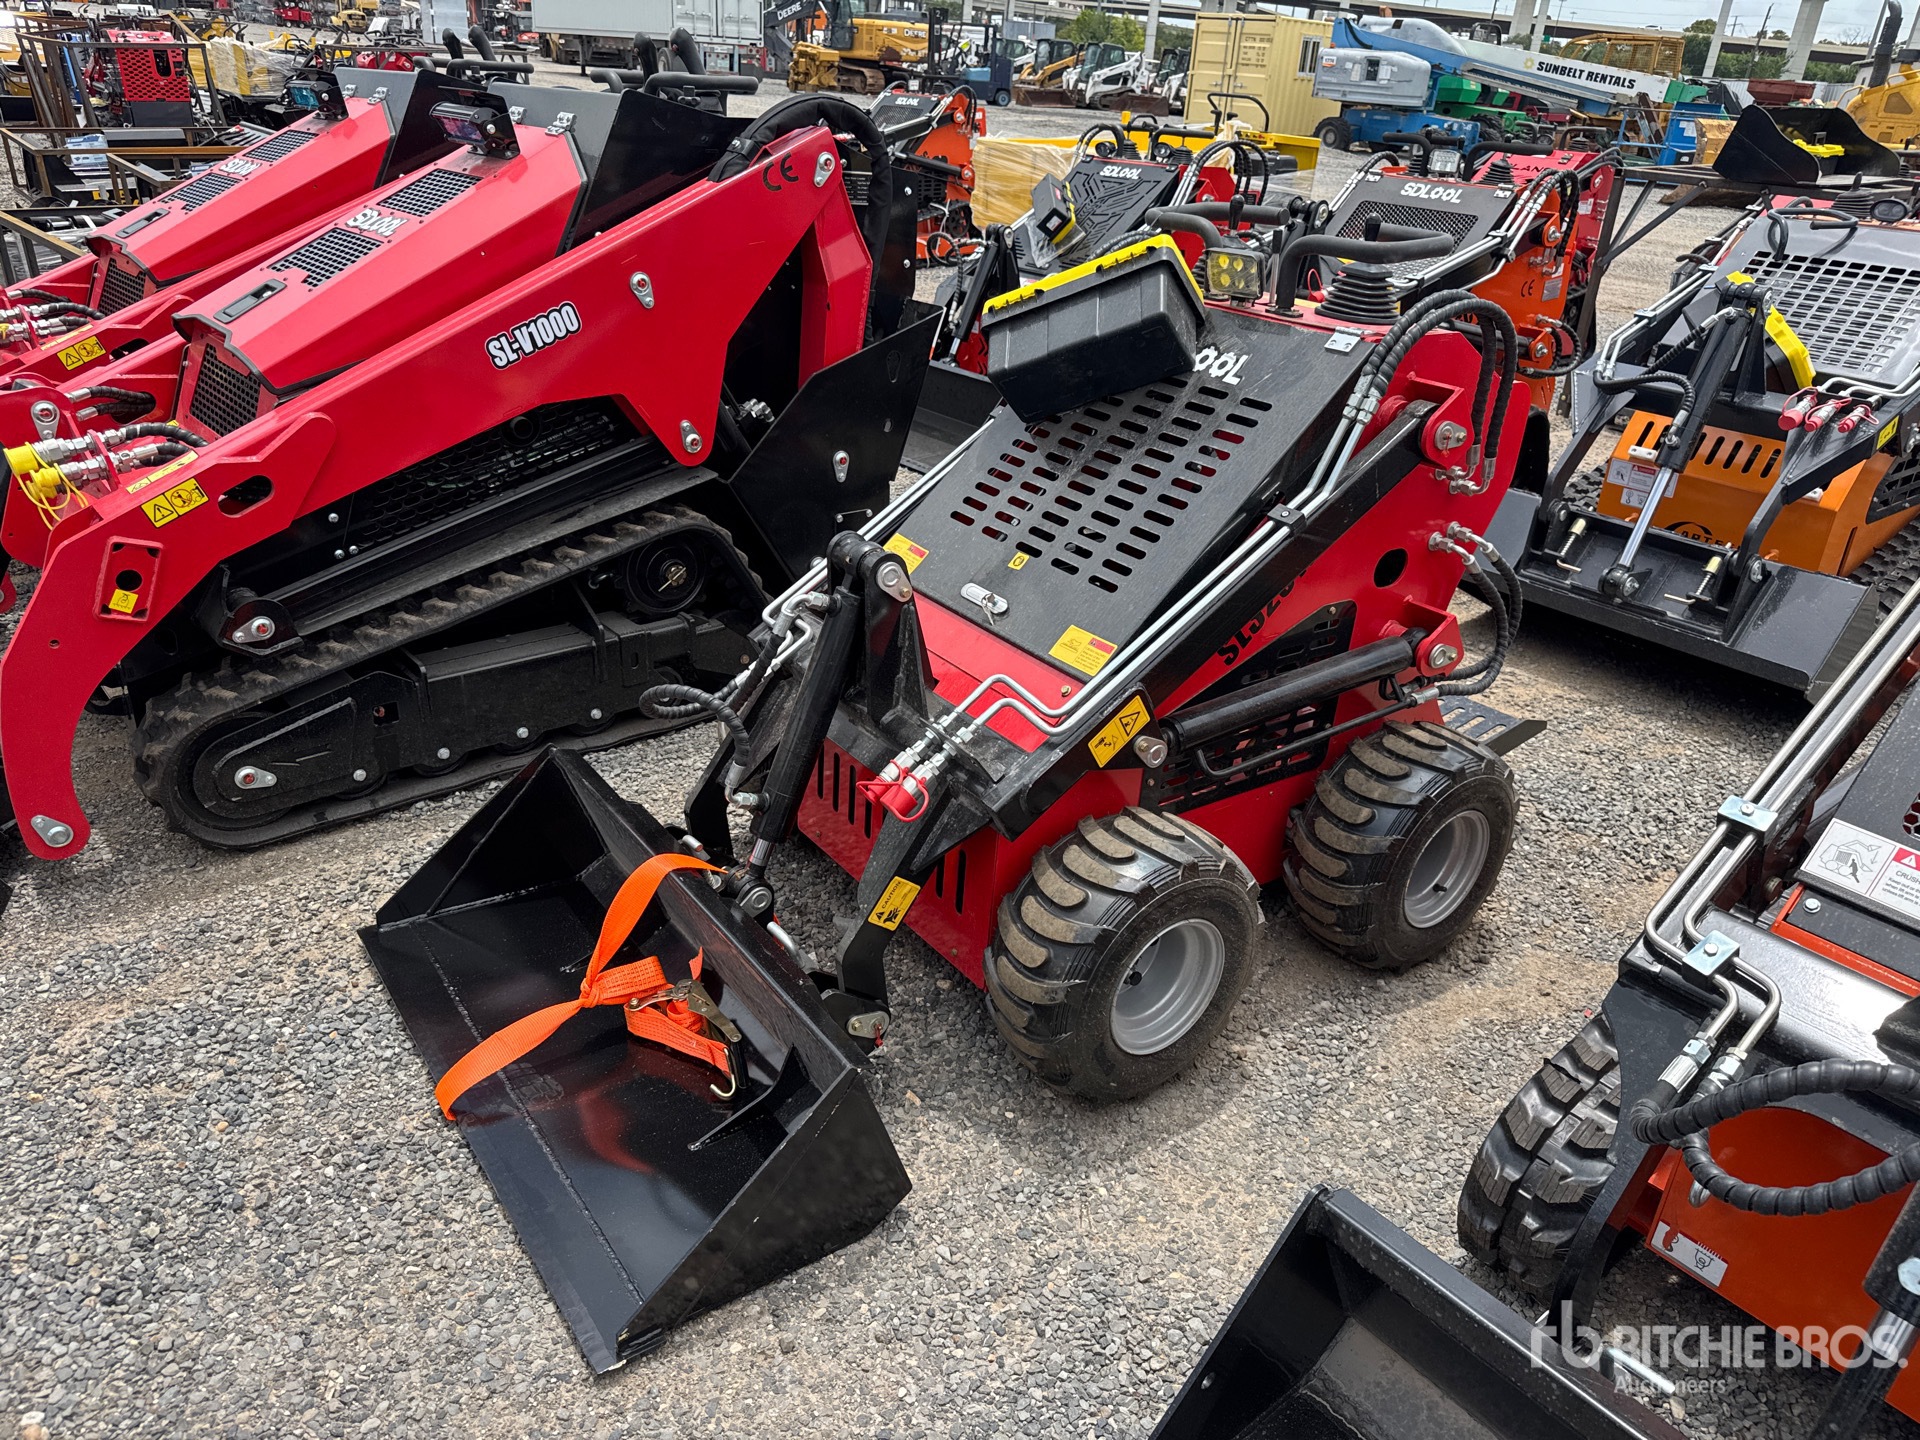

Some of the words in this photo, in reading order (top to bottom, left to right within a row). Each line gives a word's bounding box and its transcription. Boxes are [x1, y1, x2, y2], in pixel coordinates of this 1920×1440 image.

[777, 1, 802, 21] DEERE
[904, 28, 927, 38] DEERE
[1536, 61, 1585, 80] SUNBELT
[1586, 71, 1636, 89] RENTALS
[762, 152, 799, 192] CE
[1099, 165, 1142, 180] SDLOOL
[1400, 182, 1463, 204] SDLOOL
[1521, 279, 1535, 297] CE
[487, 303, 580, 368] SL-V1000
[881, 881, 901, 909] CAUTION
